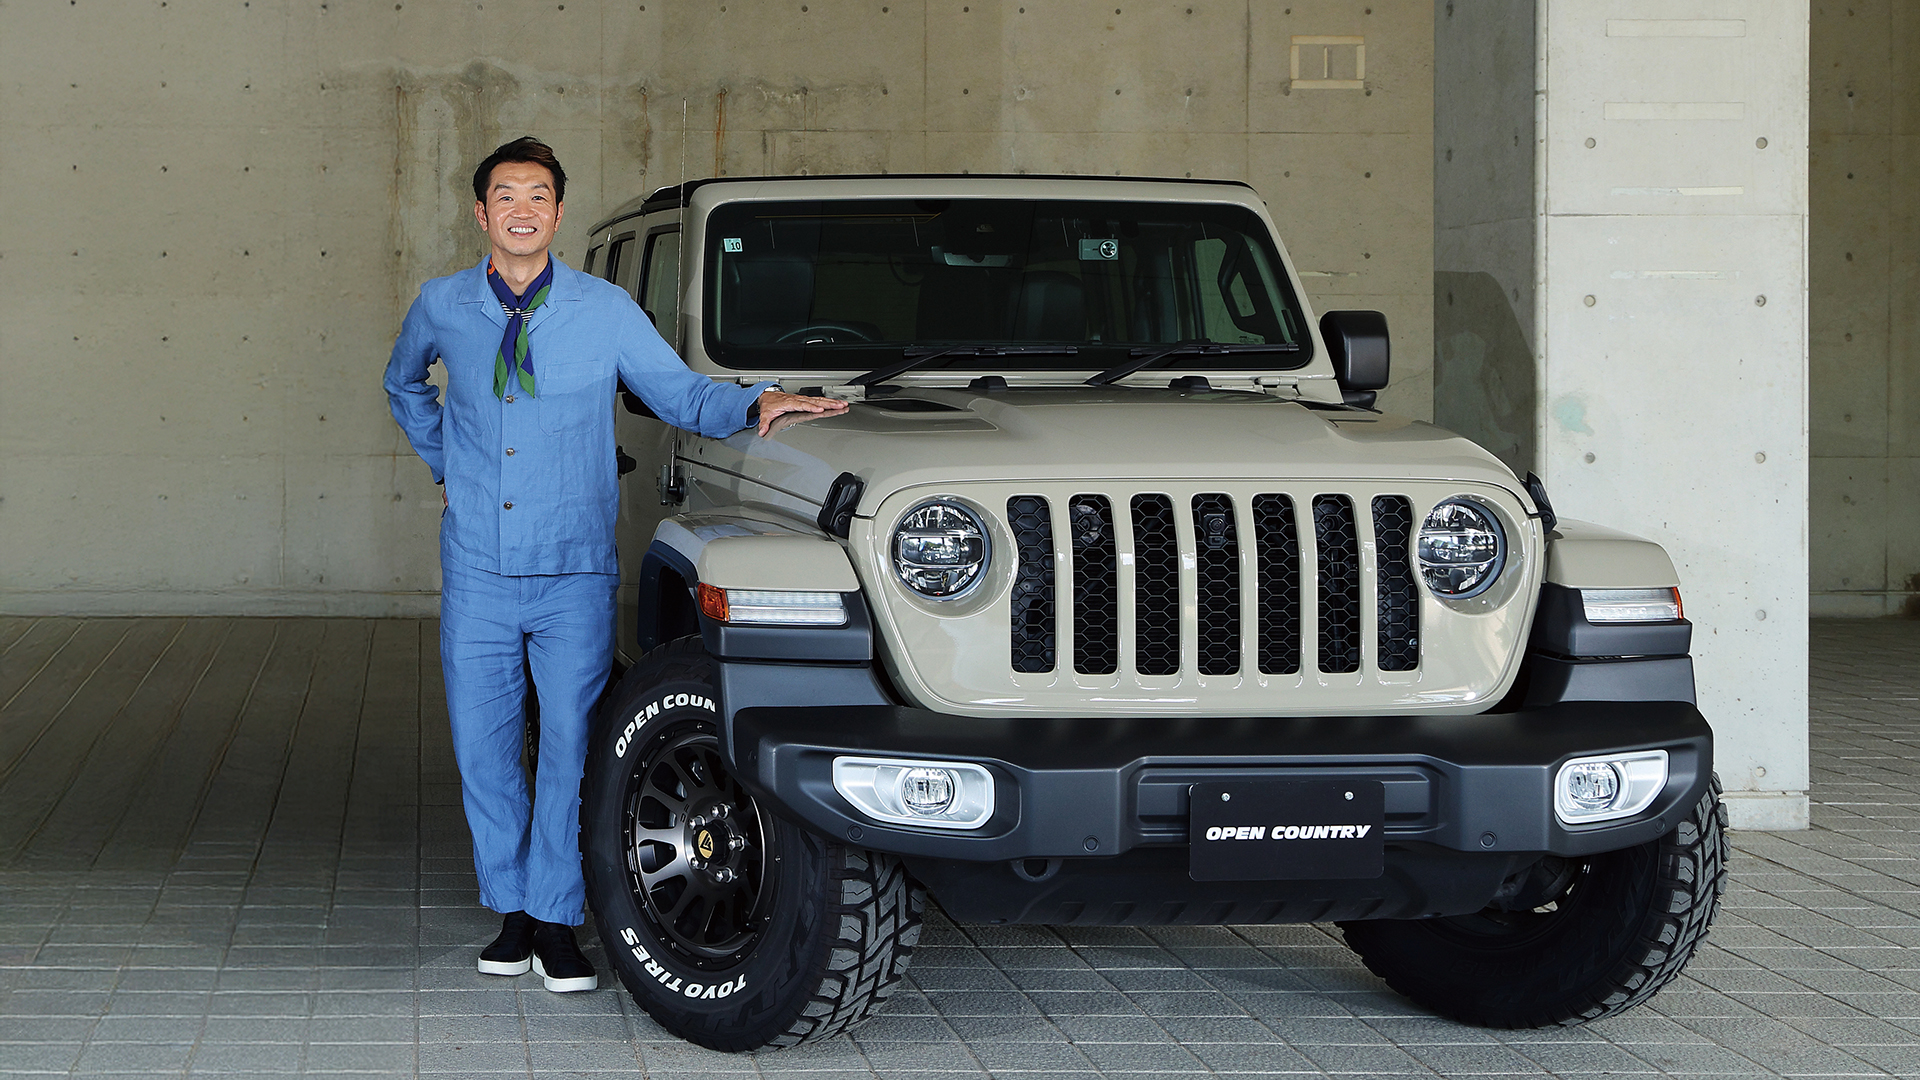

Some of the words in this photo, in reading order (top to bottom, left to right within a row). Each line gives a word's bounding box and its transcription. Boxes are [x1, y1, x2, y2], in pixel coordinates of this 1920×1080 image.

[731, 241, 741, 251] 10
[614, 701, 660, 760] OPEN
[1205, 826, 1266, 841] OPEN
[1271, 824, 1372, 840] COUNTRY
[619, 926, 684, 994] TIRES
[683, 973, 748, 1000] TOYO
